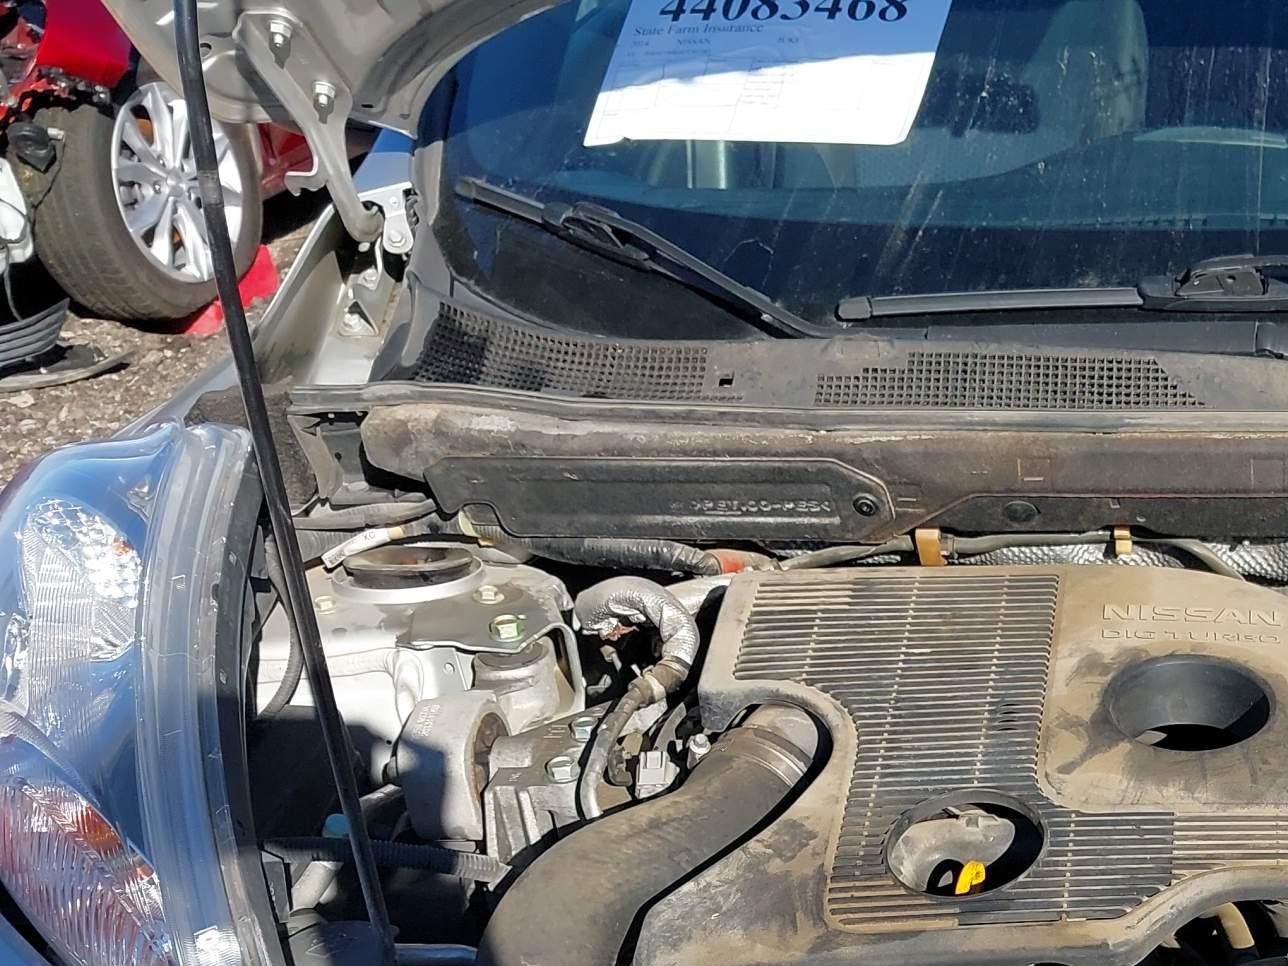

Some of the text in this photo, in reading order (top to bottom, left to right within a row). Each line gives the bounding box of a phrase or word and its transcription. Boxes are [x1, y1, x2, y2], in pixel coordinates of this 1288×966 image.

[633, 23, 765, 36] State Farm Insurance
[1101, 602, 1282, 627] NISSAN
